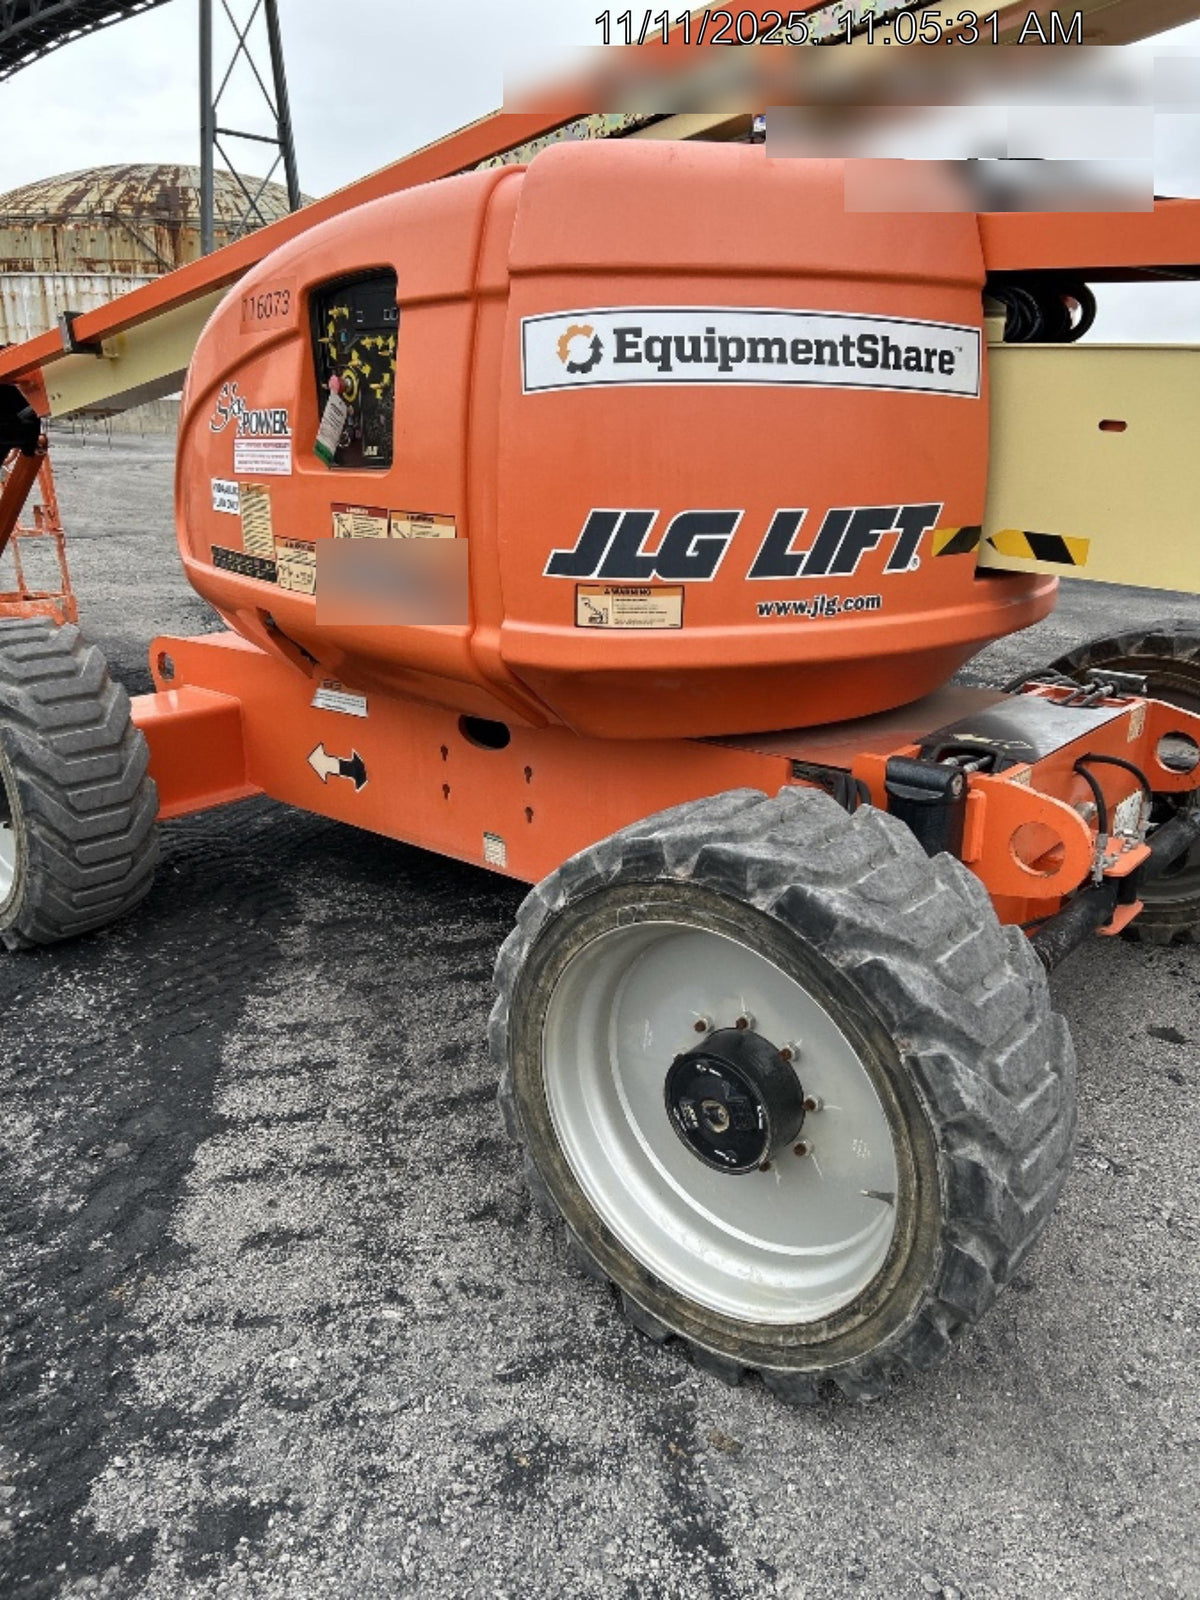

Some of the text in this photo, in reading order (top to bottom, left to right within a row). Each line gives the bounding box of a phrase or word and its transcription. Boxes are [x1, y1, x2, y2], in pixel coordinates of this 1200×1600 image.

[242, 289, 291, 322] 116073
[613, 326, 956, 375] EquipmentShare
[240, 408, 291, 437] POWER
[542, 502, 944, 582] JLG LIFT
[756, 594, 882, 618] www.jlg.com
